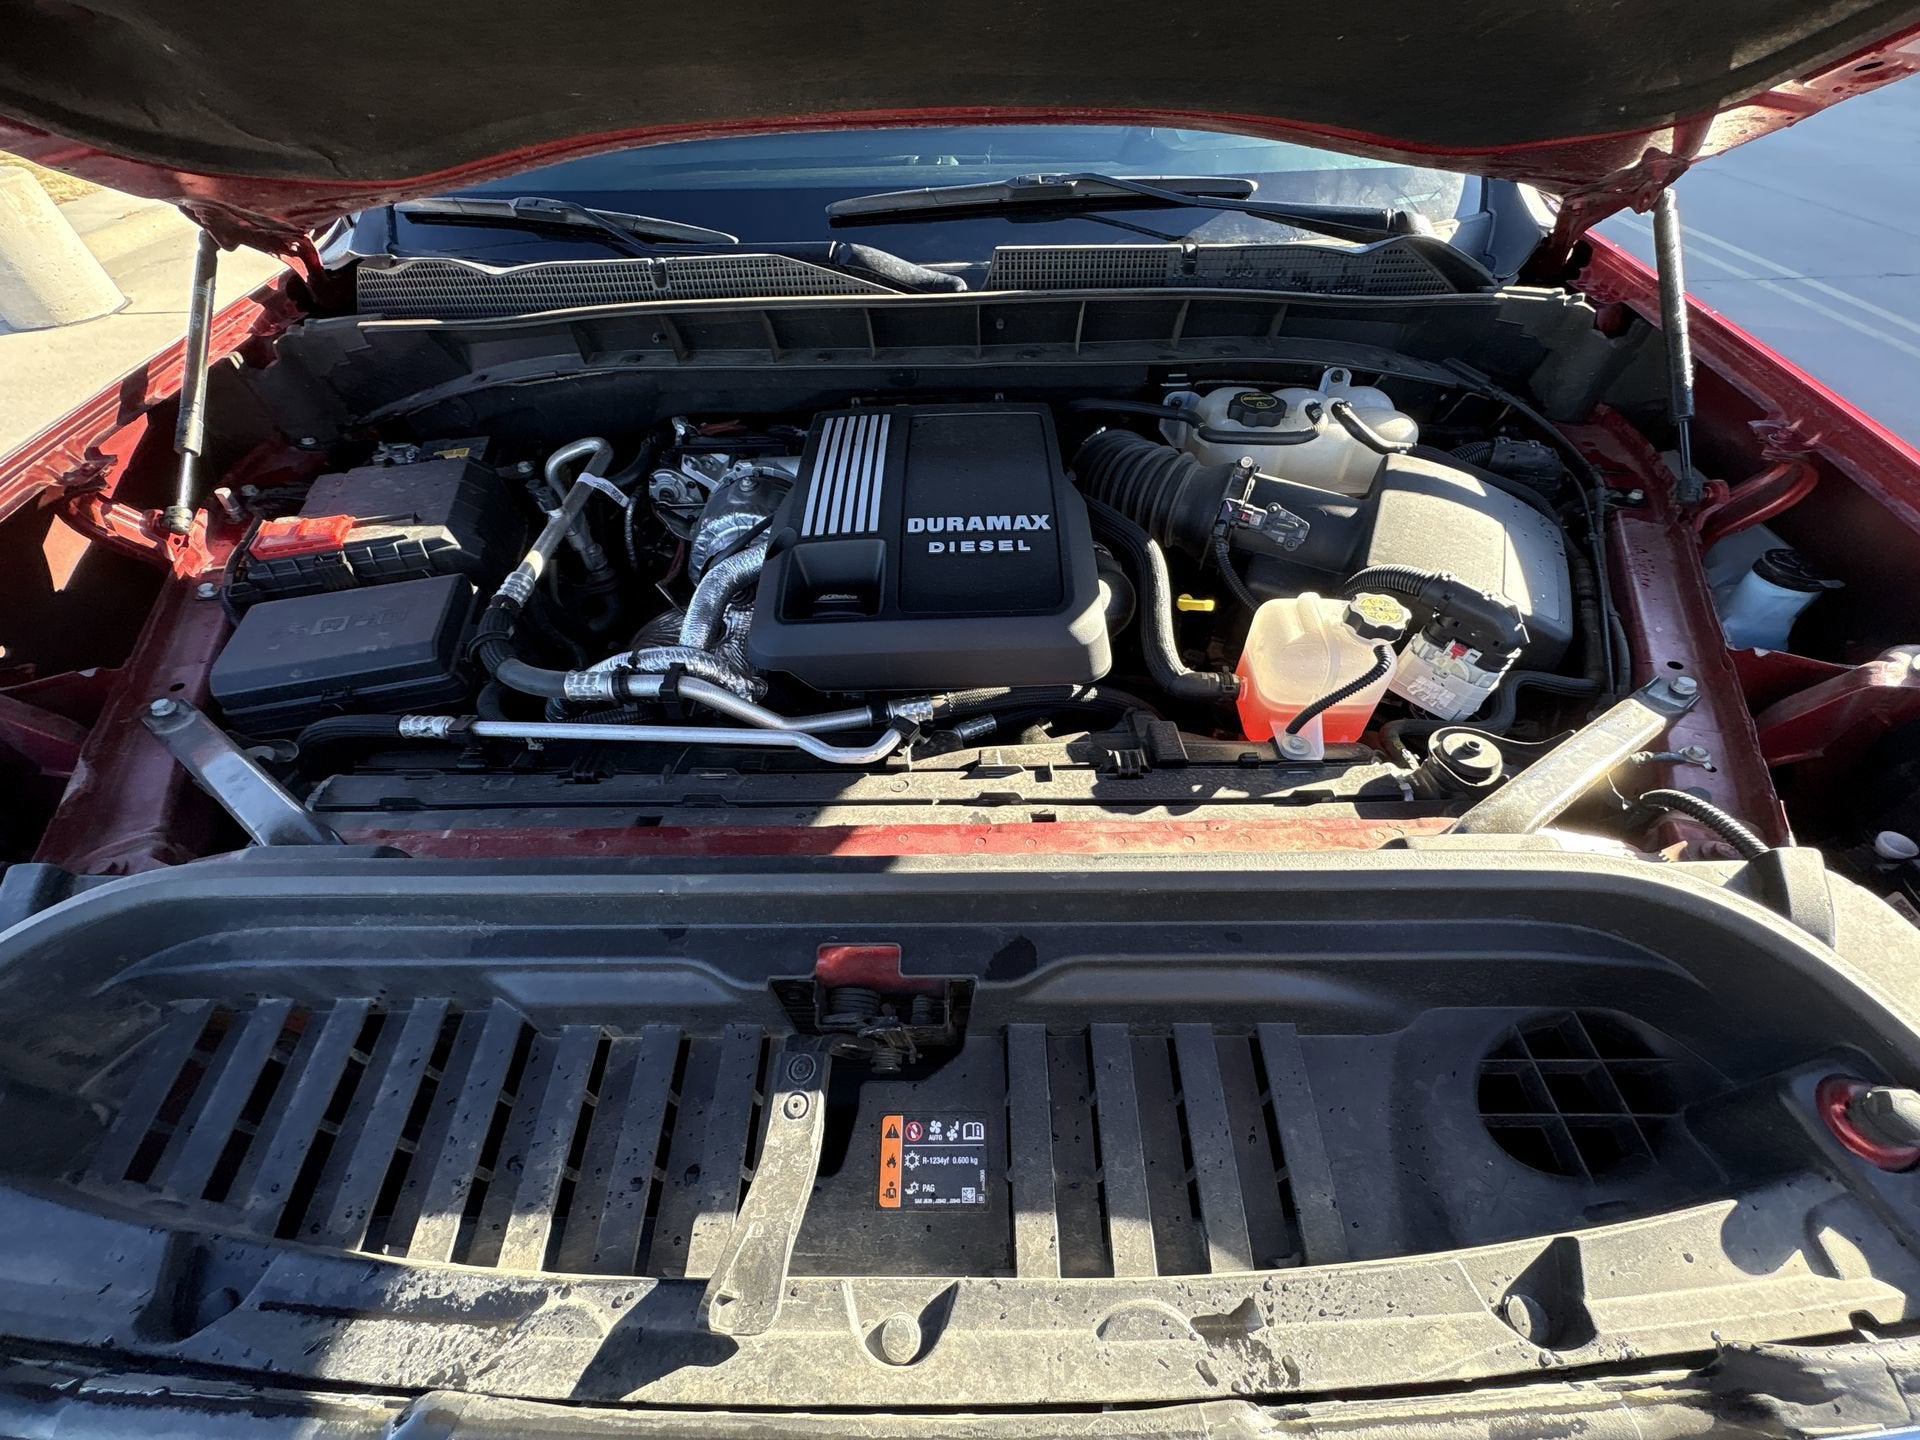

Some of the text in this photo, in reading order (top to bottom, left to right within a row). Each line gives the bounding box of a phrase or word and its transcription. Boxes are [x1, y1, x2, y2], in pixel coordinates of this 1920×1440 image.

[907, 514, 1051, 533] DURAMAX
[928, 539, 1031, 553] DIESEL
[922, 1156, 978, 1166] R-1234yf 0.600 kg
[922, 1184, 935, 1192] PAG
